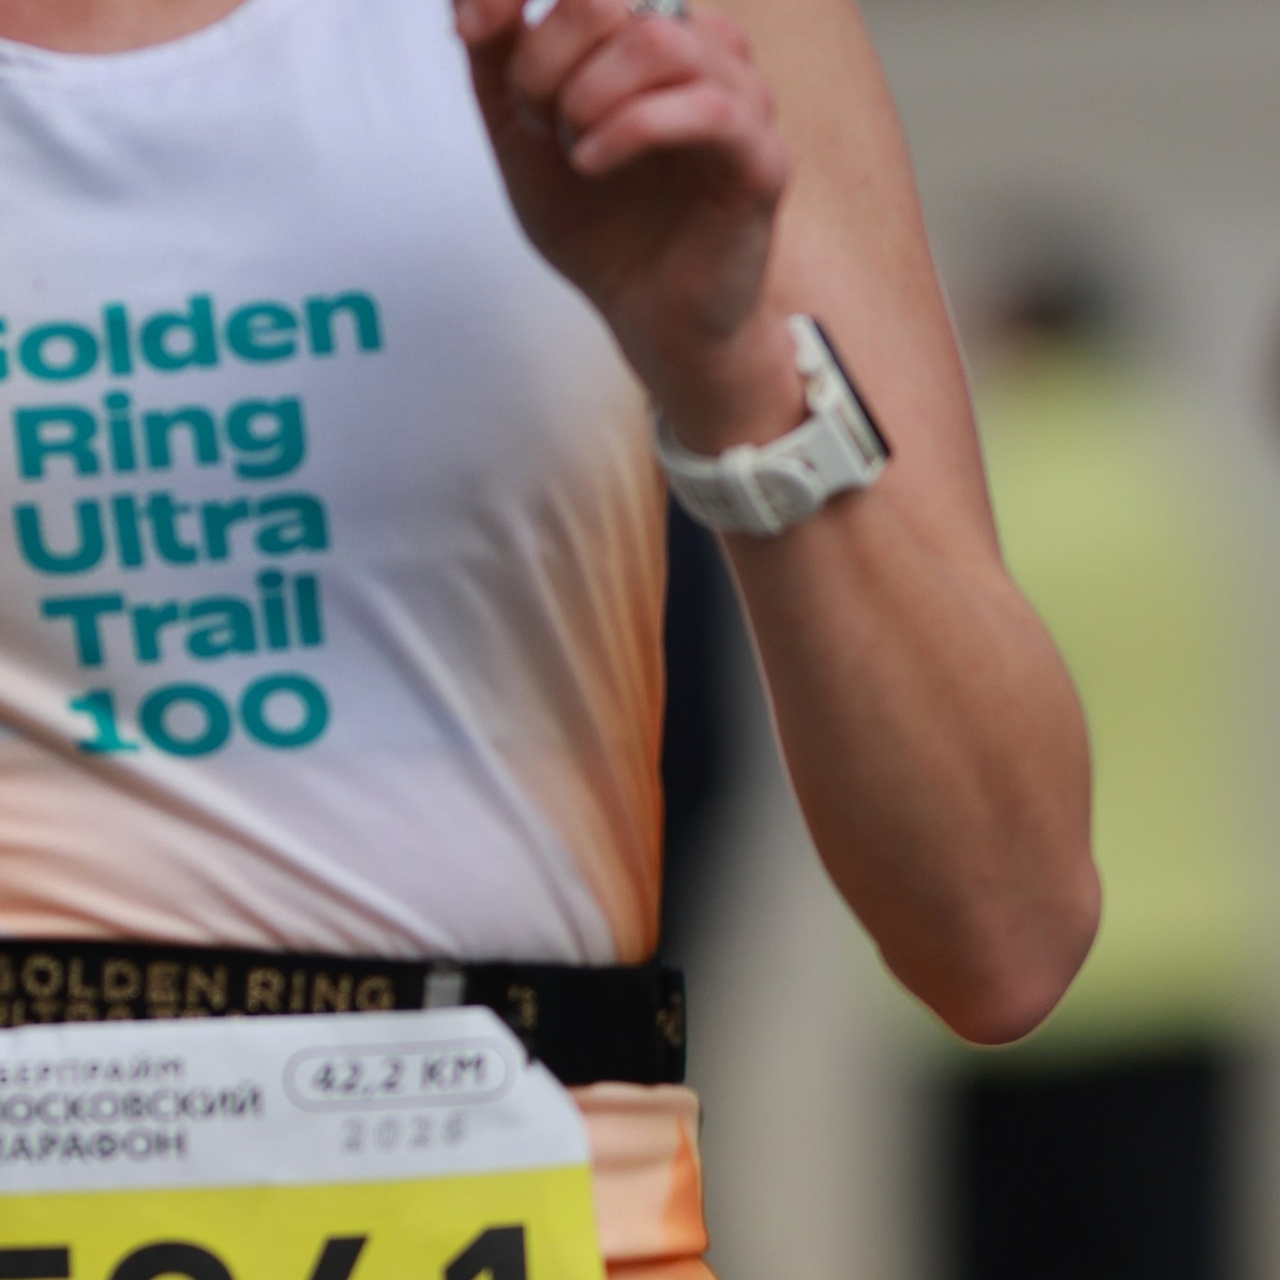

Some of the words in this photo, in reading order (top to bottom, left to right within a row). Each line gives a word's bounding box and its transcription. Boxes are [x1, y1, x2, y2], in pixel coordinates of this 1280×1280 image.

[13, 390, 308, 480] Ring
[13, 490, 332, 576] Ultra
[40, 568, 325, 668] Trail
[69, 671, 332, 758] 100
[246, 967, 396, 1013] RING
[312, 1060, 405, 1099] 42,2
